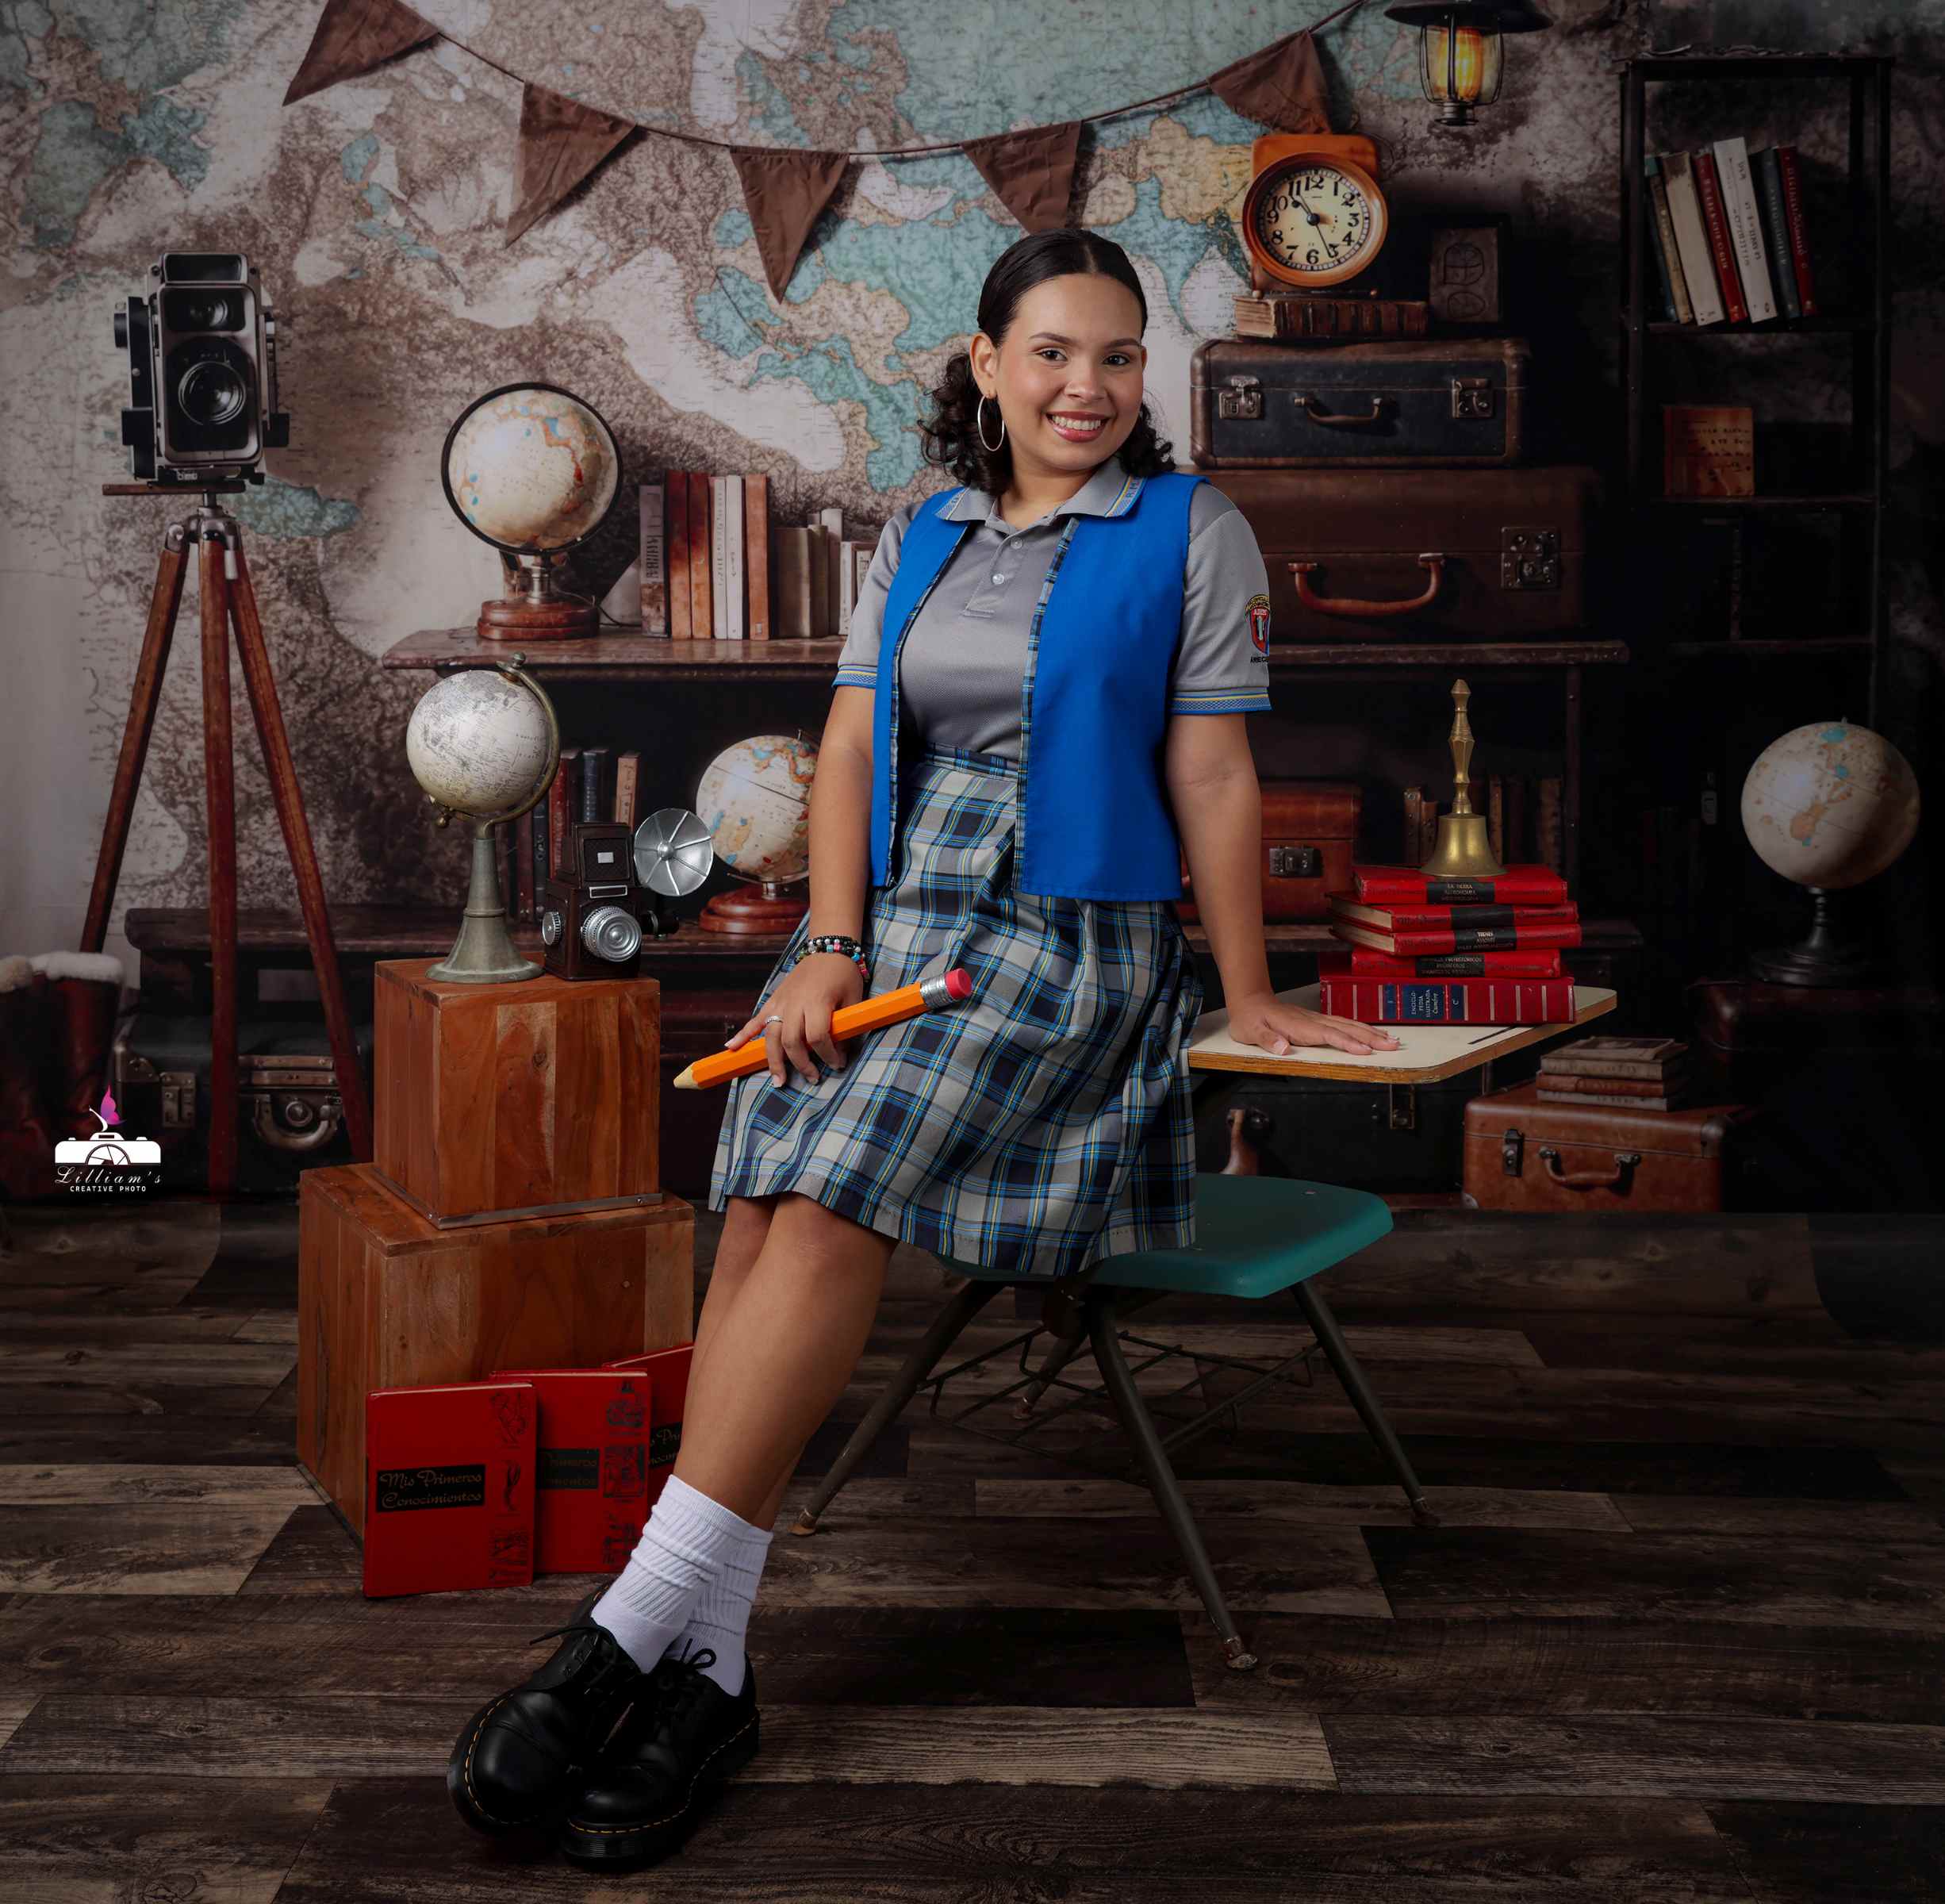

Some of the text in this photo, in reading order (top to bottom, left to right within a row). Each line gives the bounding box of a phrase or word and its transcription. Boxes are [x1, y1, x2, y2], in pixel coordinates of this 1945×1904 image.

[1304, 176, 1325, 191] 12
[1333, 181, 1339, 196] 1
[1273, 195, 1288, 211] 10
[1341, 193, 1356, 208] 2
[1268, 209, 1279, 225] 9
[1348, 213, 1360, 228] 3
[1272, 229, 1283, 245] 8
[1342, 231, 1356, 247] 4
[1287, 244, 1299, 260] 7
[1306, 249, 1319, 264] 6
[1329, 243, 1340, 259] 5
[380, 1469, 482, 1491] Mis Primeros
[382, 1489, 482, 1509] Conocimientos
